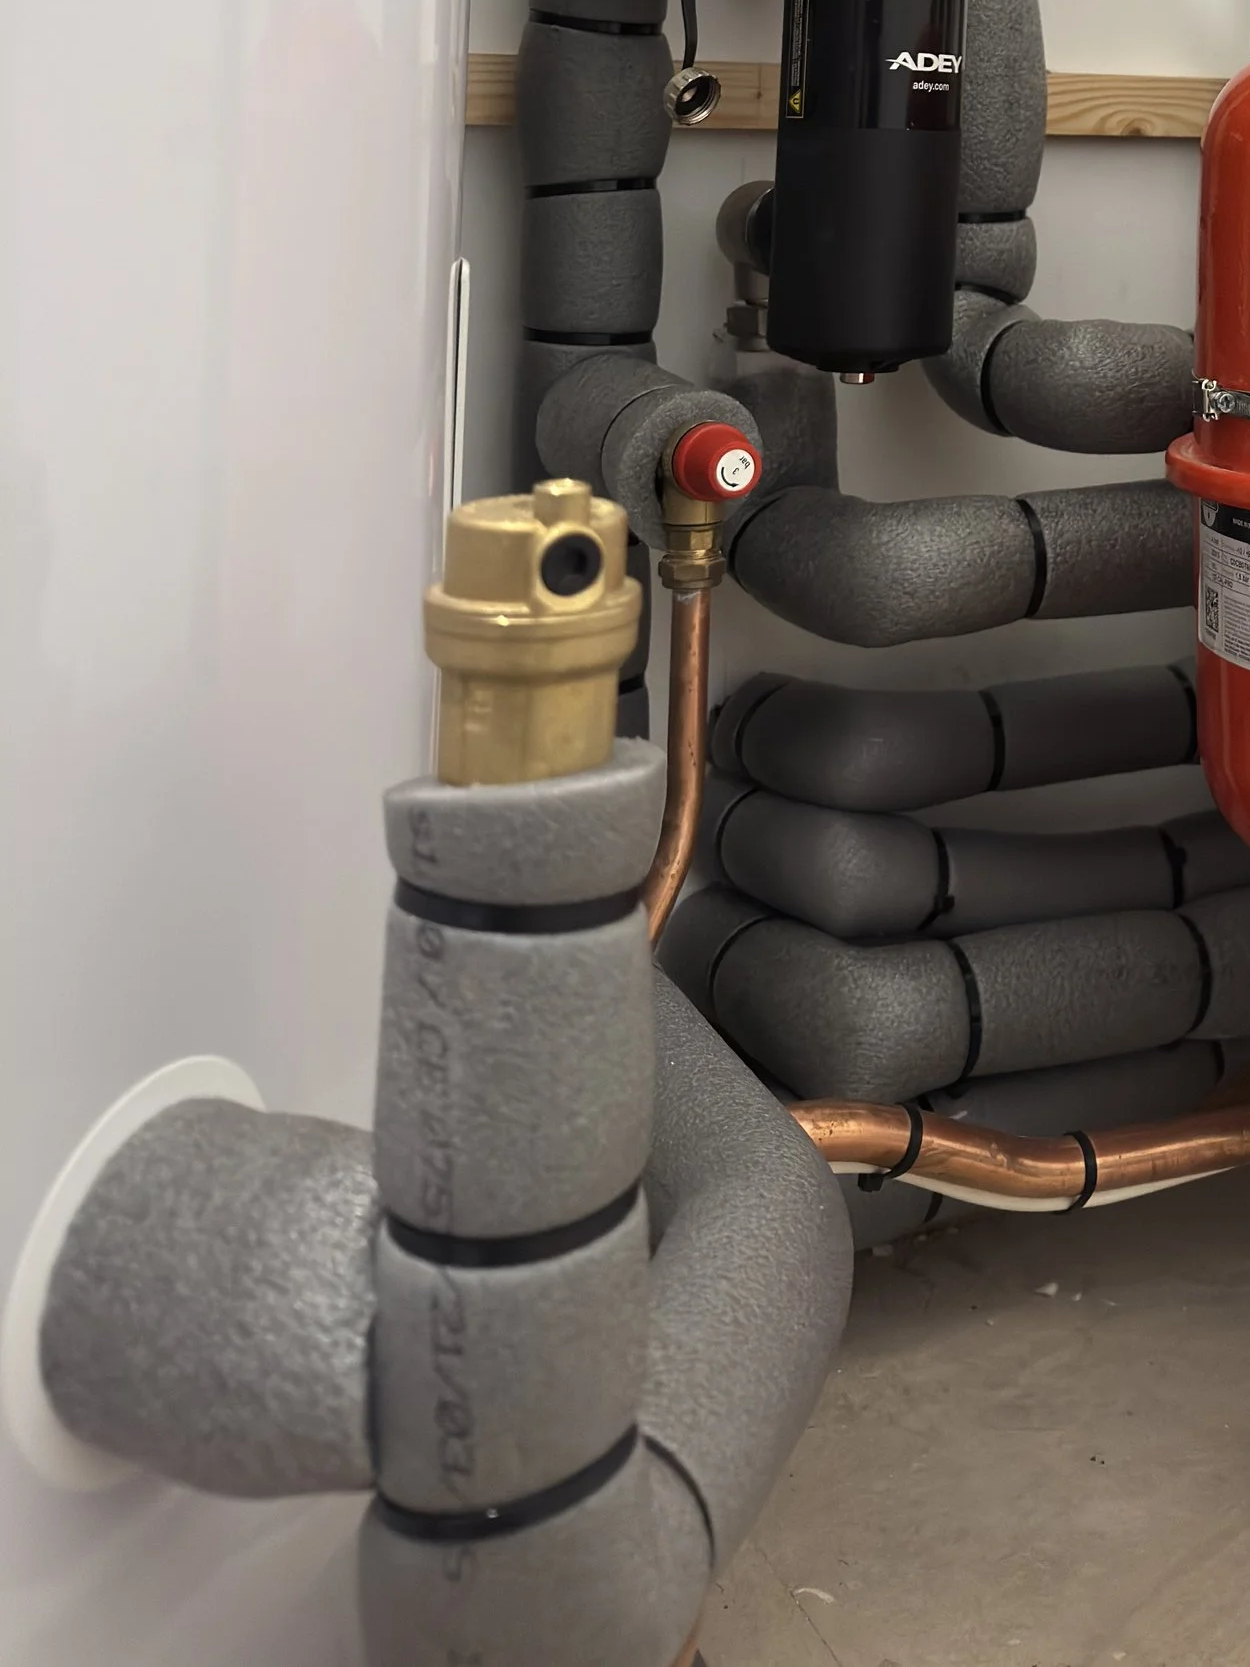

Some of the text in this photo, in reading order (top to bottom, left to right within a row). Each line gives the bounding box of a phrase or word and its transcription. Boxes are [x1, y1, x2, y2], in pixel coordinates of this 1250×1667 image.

[885, 51, 963, 74] ADEY
[912, 81, 950, 92] adey.com
[739, 455, 751, 470] bar
